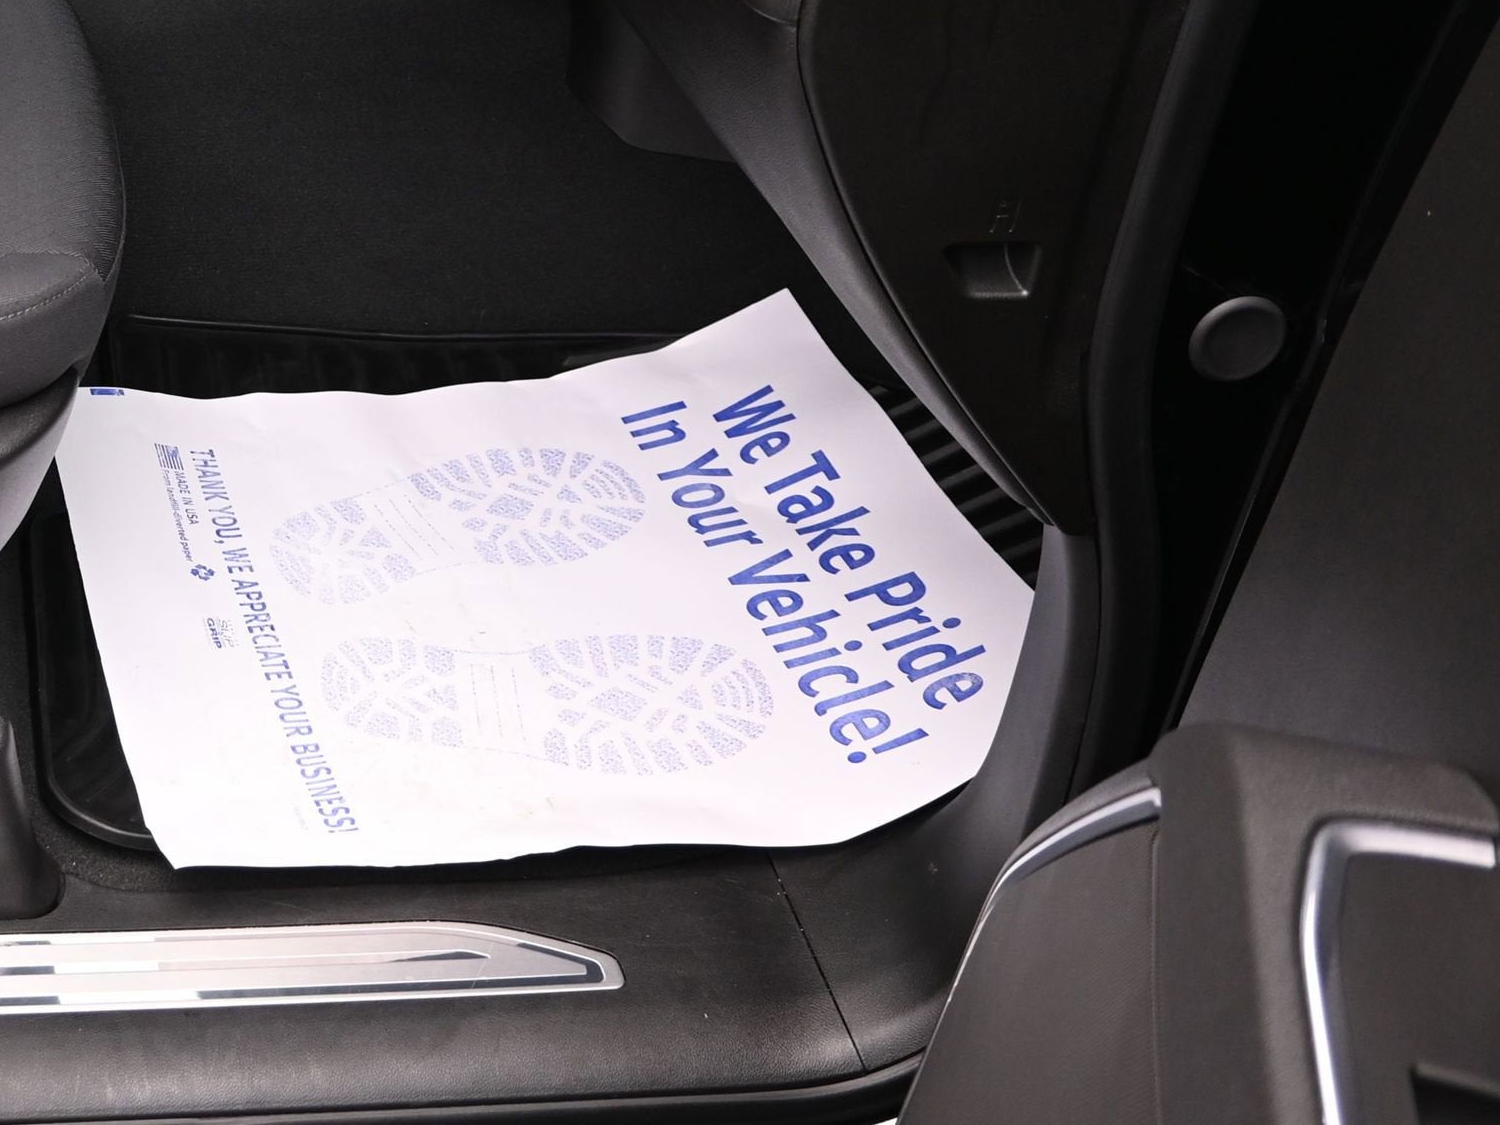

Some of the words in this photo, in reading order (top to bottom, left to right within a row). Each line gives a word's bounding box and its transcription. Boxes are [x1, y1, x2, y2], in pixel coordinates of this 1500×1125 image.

[175, 471, 190, 494] MADE
[189, 449, 230, 501] THANK
[182, 496, 195, 506] IN
[185, 508, 199, 525] USA
[208, 504, 243, 544] YOU,
[180, 540, 193, 562] paper
[221, 547, 255, 574] WE
[712, 384, 798, 465] We
[763, 449, 876, 575] Take
[843, 570, 987, 711] Pride
[620, 400, 688, 452] In
[656, 447, 764, 548] Your
[727, 548, 930, 764] Vehicle!
[206, 617, 222, 649] GRIP
[231, 579, 293, 681] APPRECIATE
[270, 684, 313, 738] YOUR
[290, 742, 359, 833] BUSINESS!
